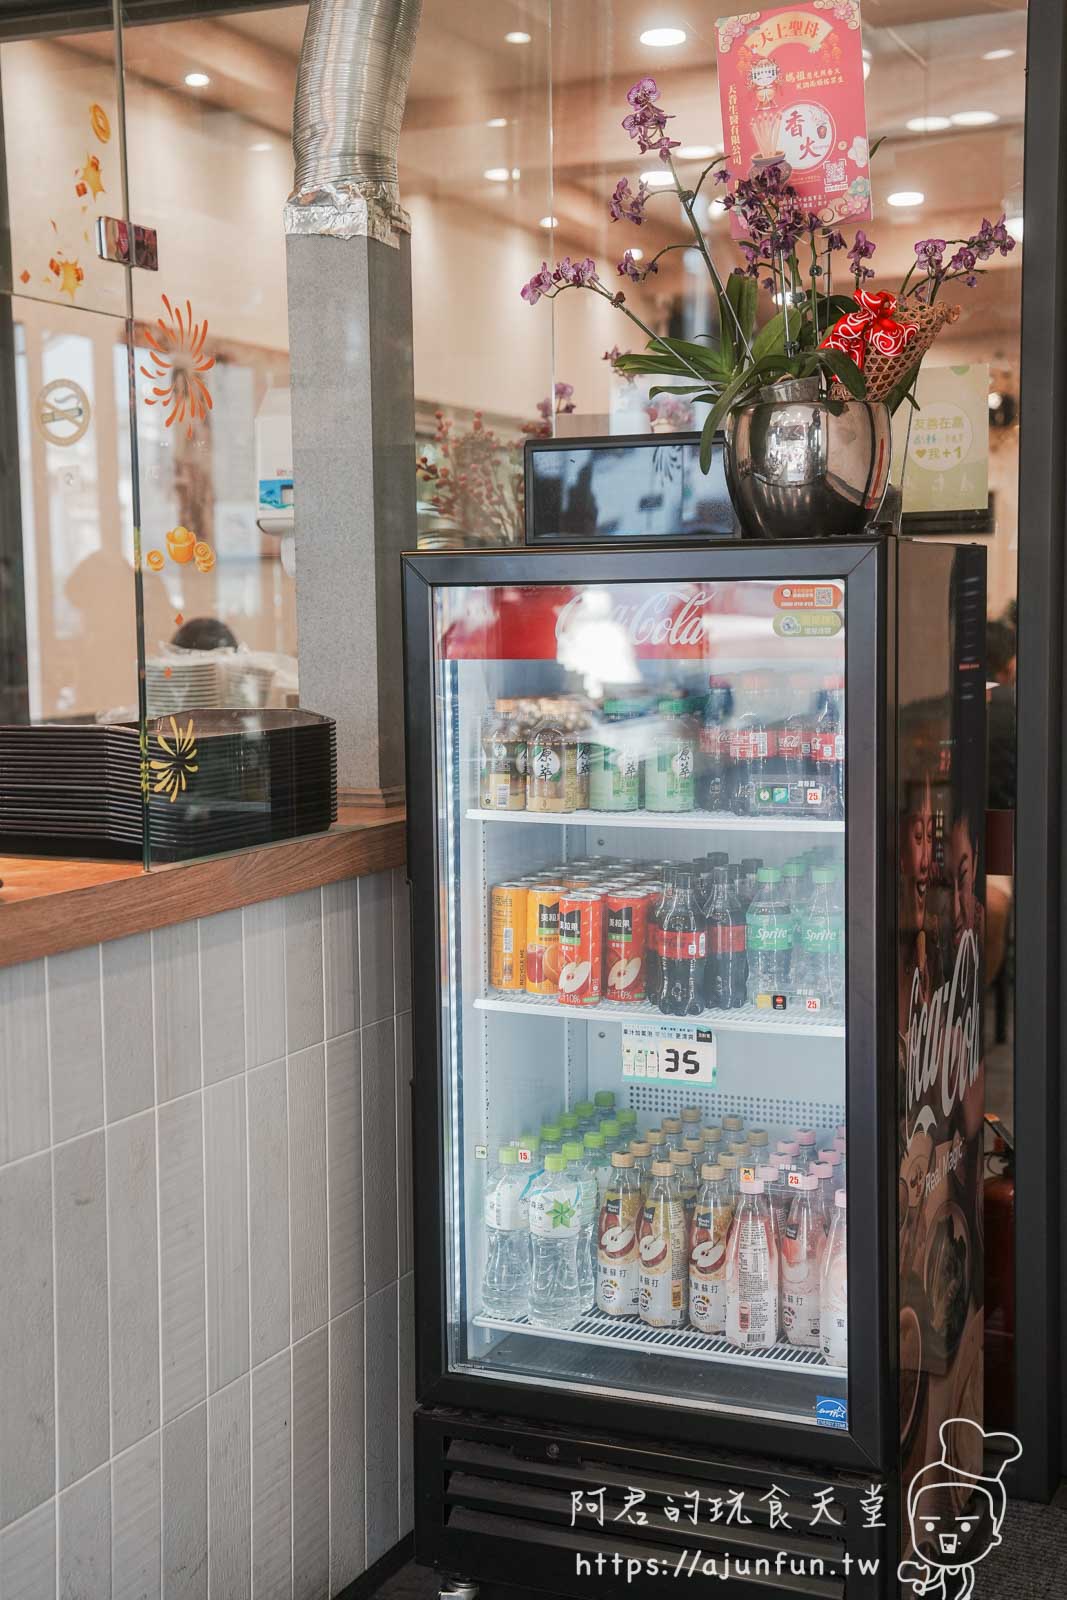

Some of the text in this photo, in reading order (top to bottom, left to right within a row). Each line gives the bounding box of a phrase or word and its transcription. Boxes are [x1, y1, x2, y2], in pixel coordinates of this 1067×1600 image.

[760, 19, 820, 49] 天上聖母
[785, 110, 821, 160] 香火
[537, 746, 563, 782] 原萃
[808, 792, 818, 800] 25
[541, 913, 560, 922] 美粒
[609, 918, 631, 928] 美粒果
[756, 927, 788, 941] Sprite
[805, 928, 837, 941] Sprite
[807, 1000, 817, 1009] 25
[664, 1048, 700, 1075] 35
[789, 1175, 799, 1185] 25
